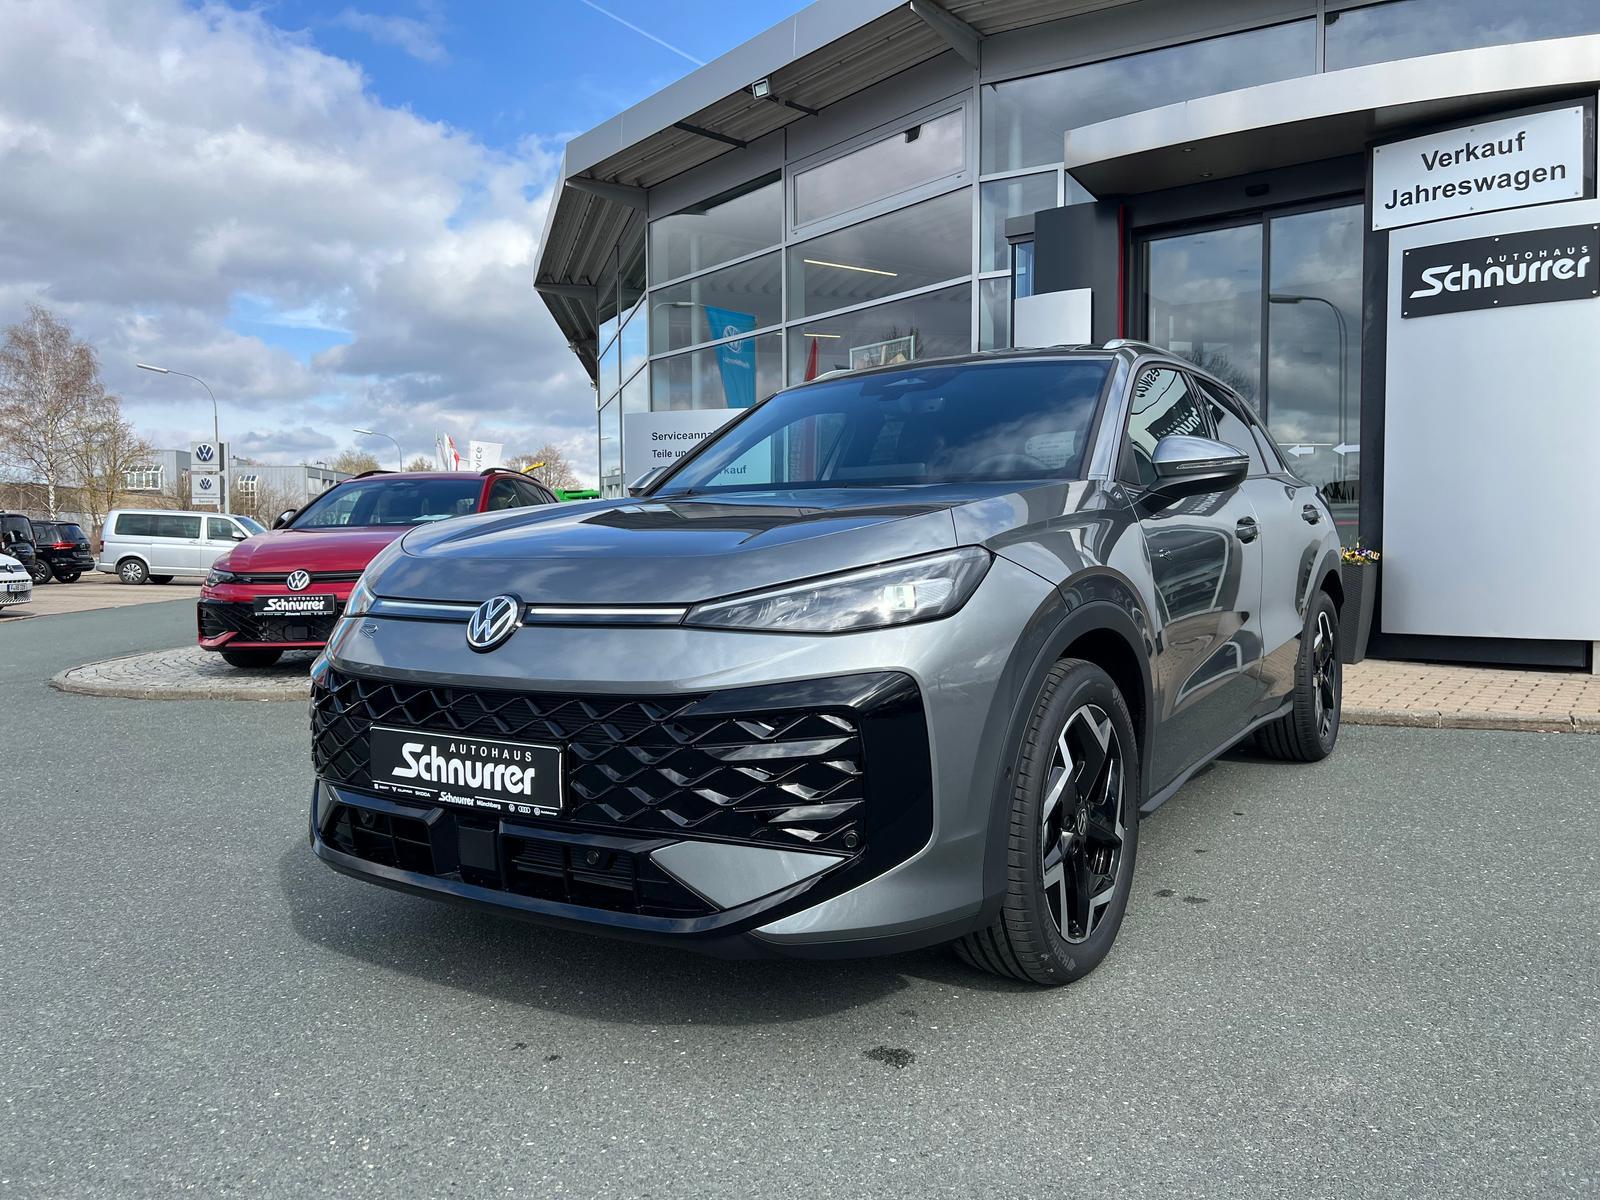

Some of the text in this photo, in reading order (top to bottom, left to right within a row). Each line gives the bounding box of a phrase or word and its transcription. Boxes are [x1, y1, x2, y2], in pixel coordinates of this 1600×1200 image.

[1421, 131, 1526, 171] Verkauf
[1384, 164, 1566, 210] Jahreswagen
[1486, 245, 1588, 265] AUTOHAUS
[1409, 256, 1591, 299] Schnurrer
[652, 449, 672, 458] Teile
[263, 598, 325, 611] Schnurrer
[449, 743, 532, 762] AUTOHAUS
[391, 742, 536, 796] Schnurrer
[438, 791, 475, 806] Schnurrer
